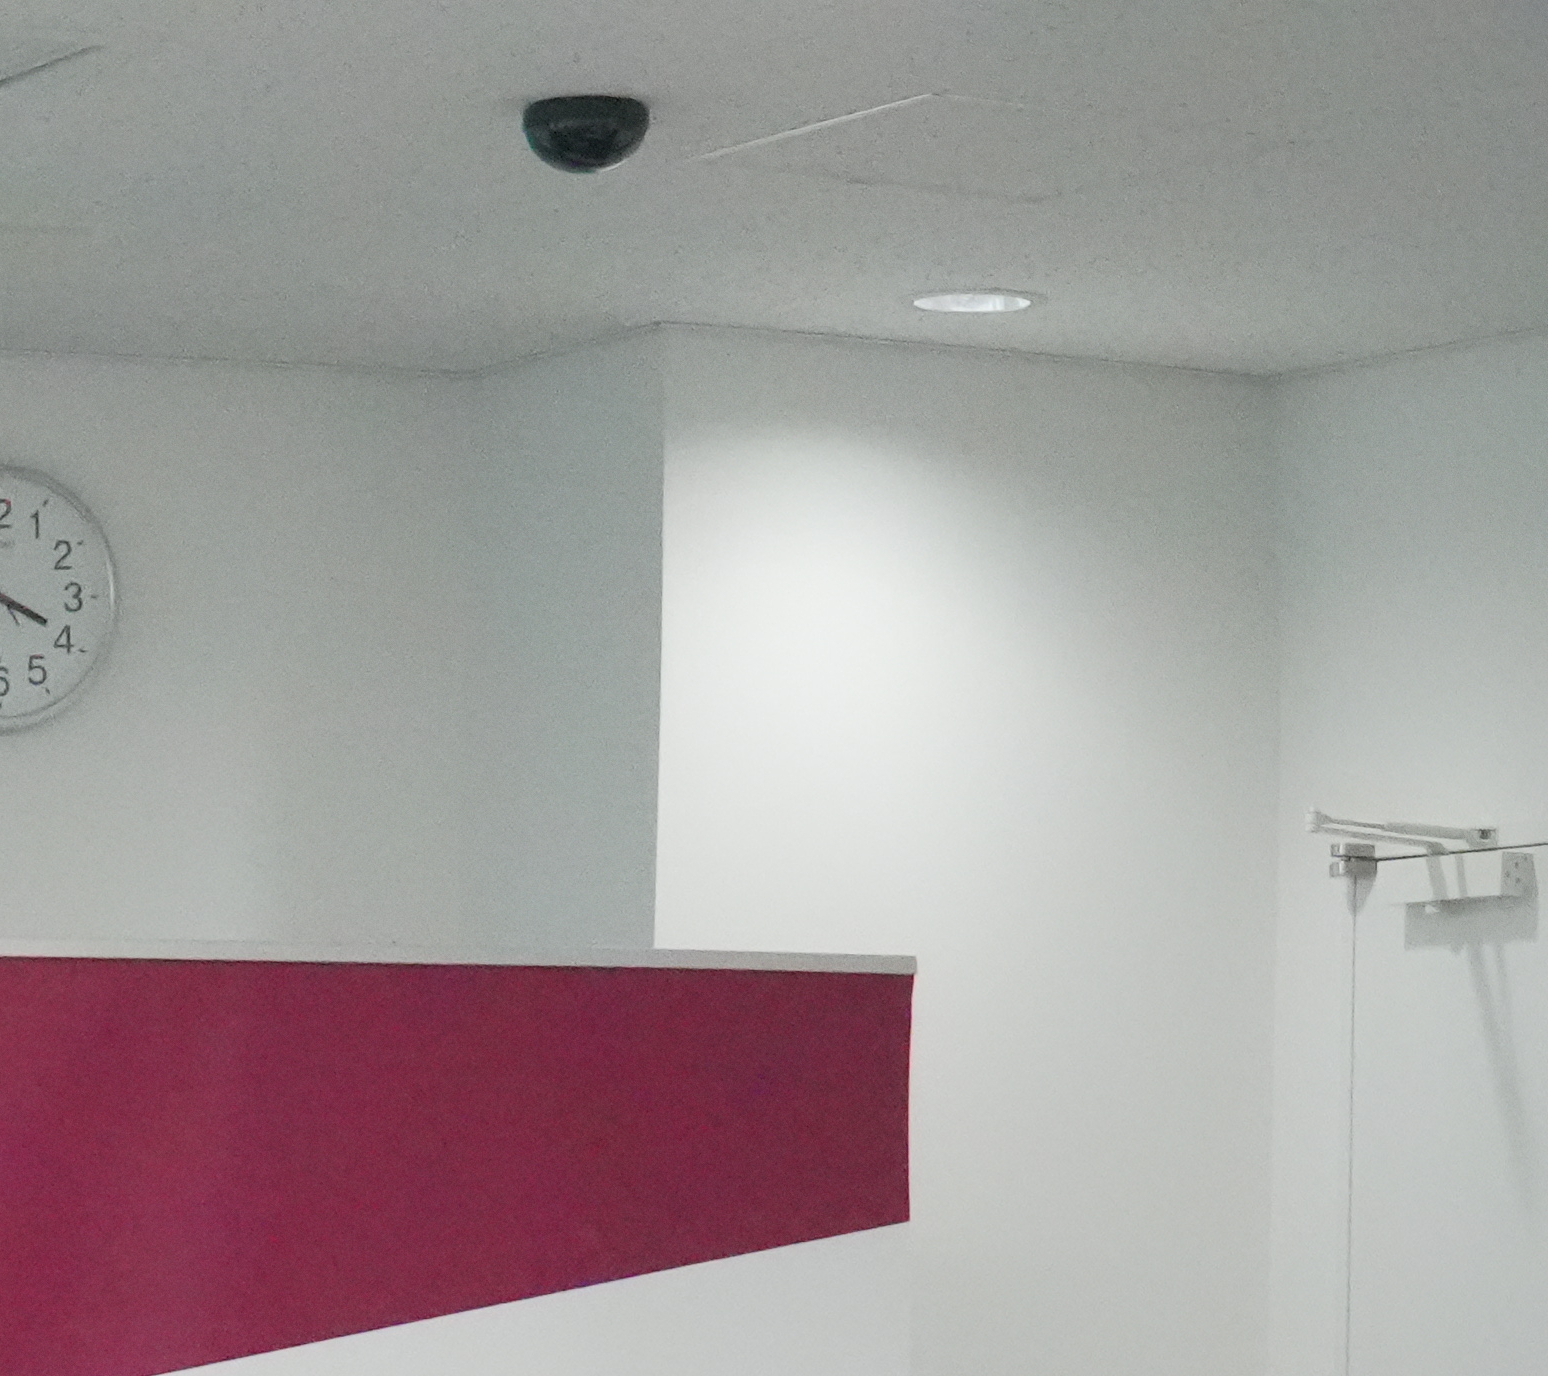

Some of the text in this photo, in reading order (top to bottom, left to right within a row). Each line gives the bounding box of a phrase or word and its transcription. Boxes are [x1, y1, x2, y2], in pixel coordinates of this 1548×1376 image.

[31, 510, 40, 539] 1
[54, 541, 72, 570] 2
[64, 583, 83, 612] 3
[54, 625, 74, 653] 4
[28, 655, 47, 685] 5
